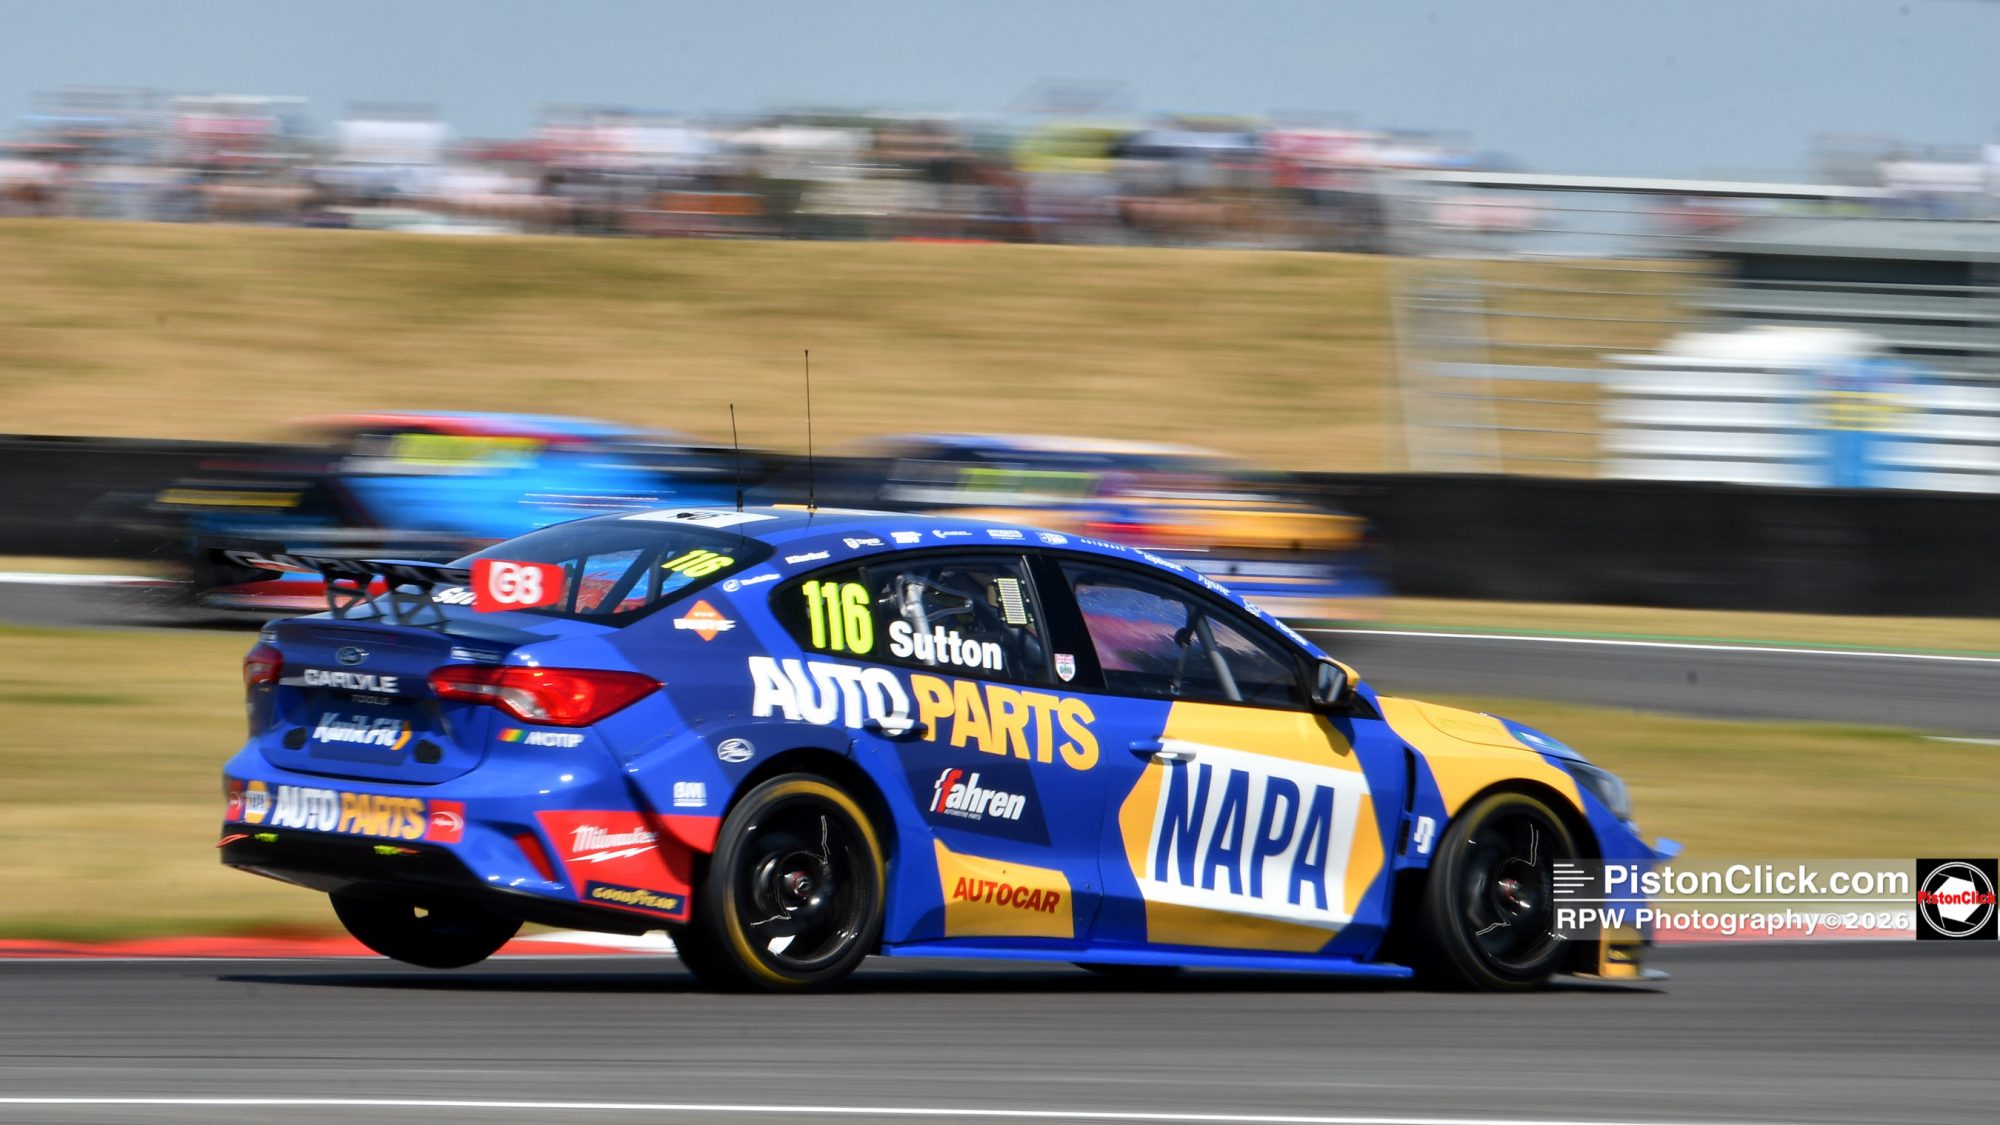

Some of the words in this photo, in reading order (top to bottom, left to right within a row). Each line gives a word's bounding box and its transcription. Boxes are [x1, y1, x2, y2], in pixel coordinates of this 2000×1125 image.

[661, 549, 735, 578] 116
[802, 580, 874, 655] 116
[889, 621, 1002, 670] Sutton
[303, 668, 401, 694] CARLYLE
[748, 655, 914, 737] AUTO
[909, 673, 1100, 771] PARTS
[523, 730, 586, 749] MOTIP
[272, 785, 340, 832] AUTO
[337, 792, 425, 840] PARTS
[930, 768, 1026, 820] fahren
[1154, 759, 1335, 912] NAPA
[953, 877, 1060, 914] AUTOCAR
